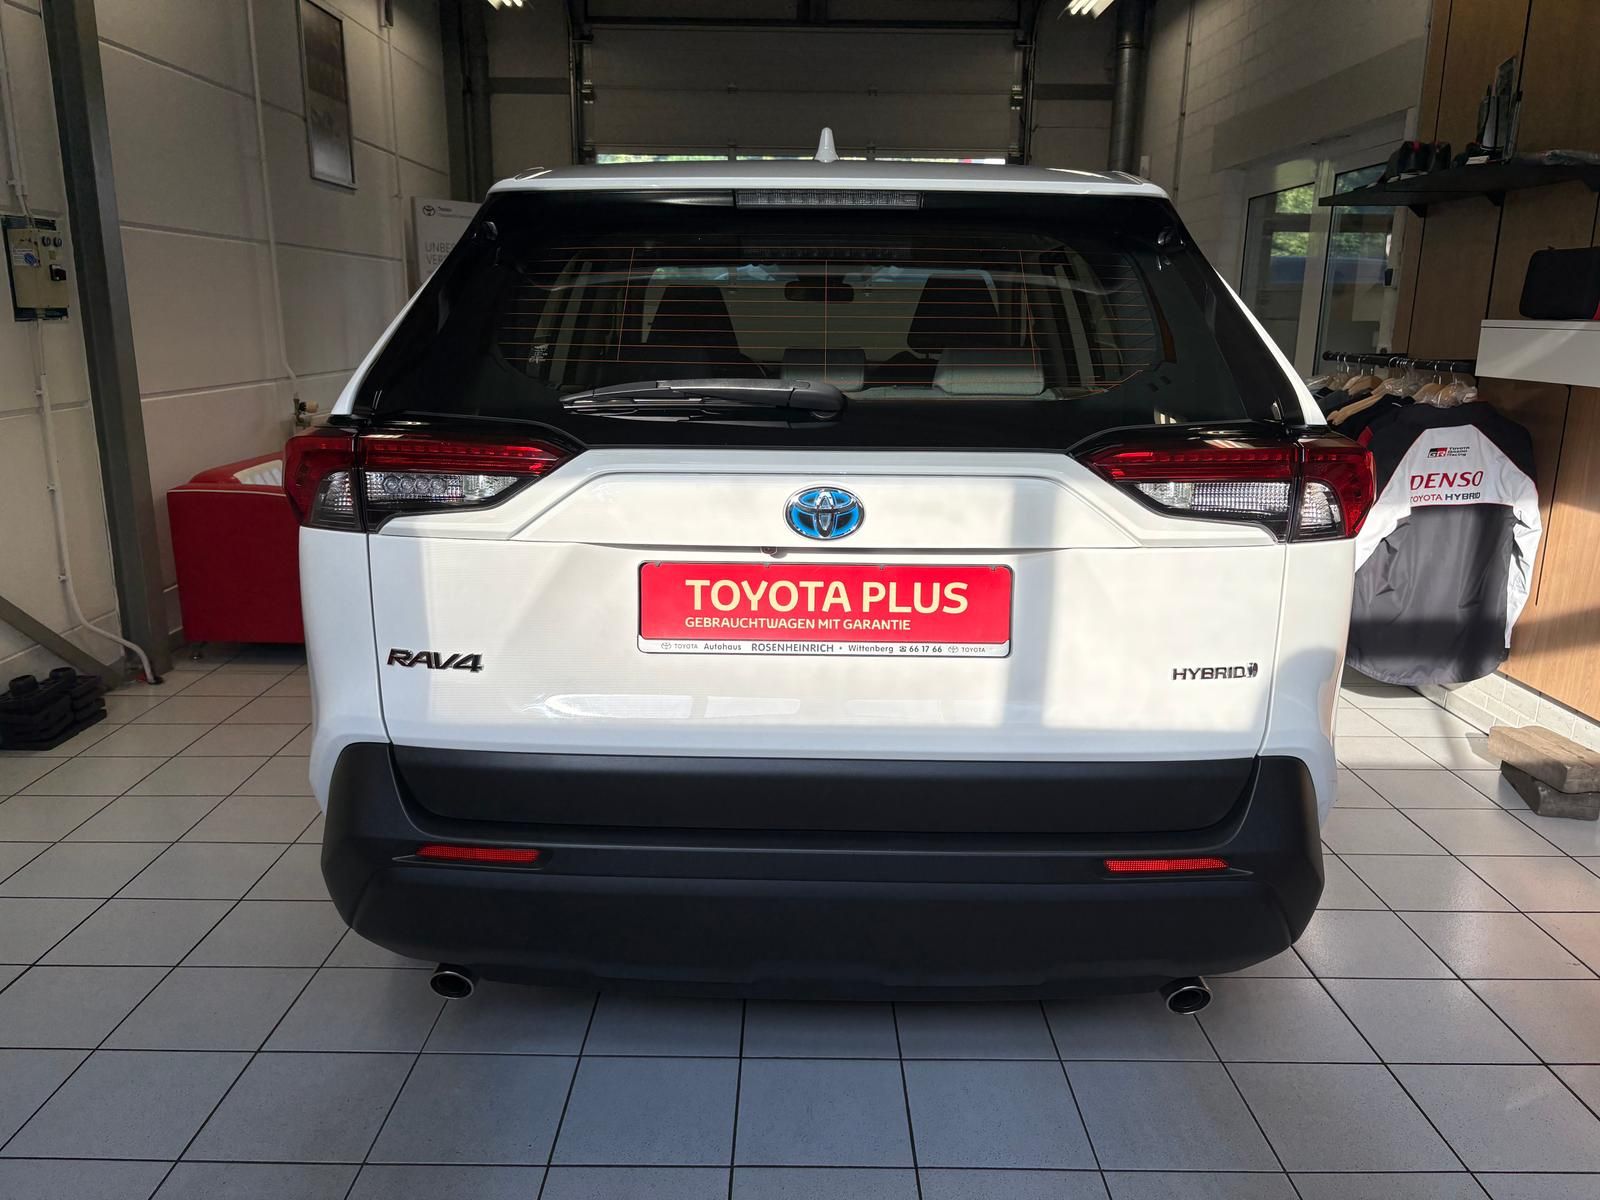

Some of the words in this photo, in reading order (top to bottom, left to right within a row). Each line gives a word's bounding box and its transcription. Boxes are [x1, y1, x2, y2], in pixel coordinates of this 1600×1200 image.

[1410, 470, 1484, 490] DENSO
[685, 579, 852, 613] TOYOTA
[862, 581, 969, 614] PLUS
[685, 616, 815, 629] GEBRAUCHTWAGEN
[818, 618, 841, 630] MIT
[843, 619, 911, 630] GARANTIE
[703, 642, 742, 651] Autohaus
[751, 643, 834, 653] ROSENHEINRICH
[848, 644, 894, 653] Wittenberg
[909, 645, 919, 653] 66
[922, 645, 930, 653] 17
[932, 645, 943, 653] 66
[387, 648, 484, 673] RAV4
[1172, 665, 1246, 680] HYBRID
